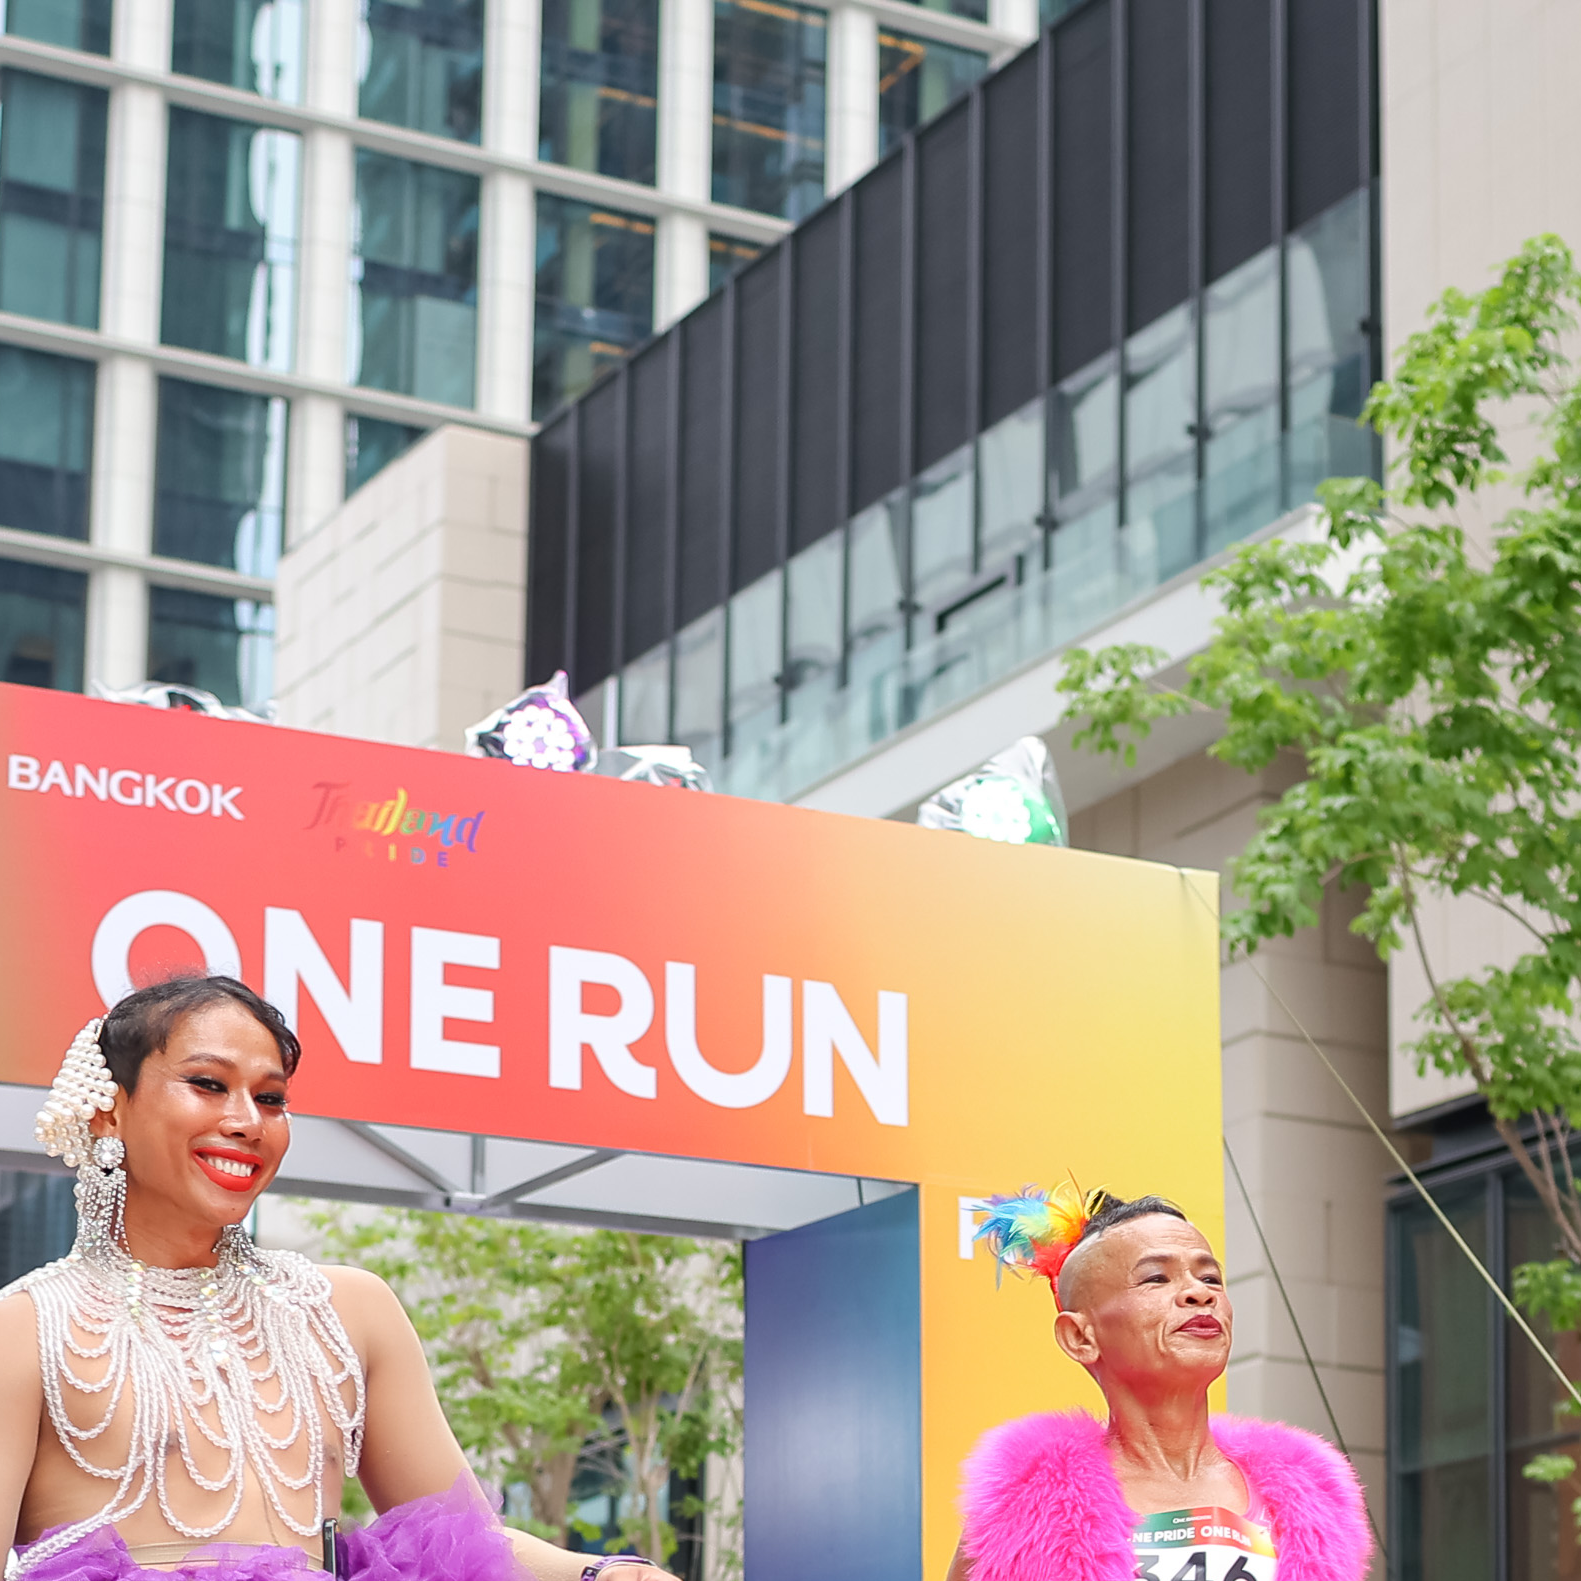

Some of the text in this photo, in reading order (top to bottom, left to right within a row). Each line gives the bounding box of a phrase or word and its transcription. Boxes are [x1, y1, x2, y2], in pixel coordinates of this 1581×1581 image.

[7, 754, 246, 820] BANGKOK
[91, 889, 500, 1079] ONE
[549, 944, 909, 1127] RUN
[1127, 1531, 1152, 1544] NE
[1154, 1527, 1195, 1542] PRIDE
[1200, 1525, 1231, 1538] ONE
